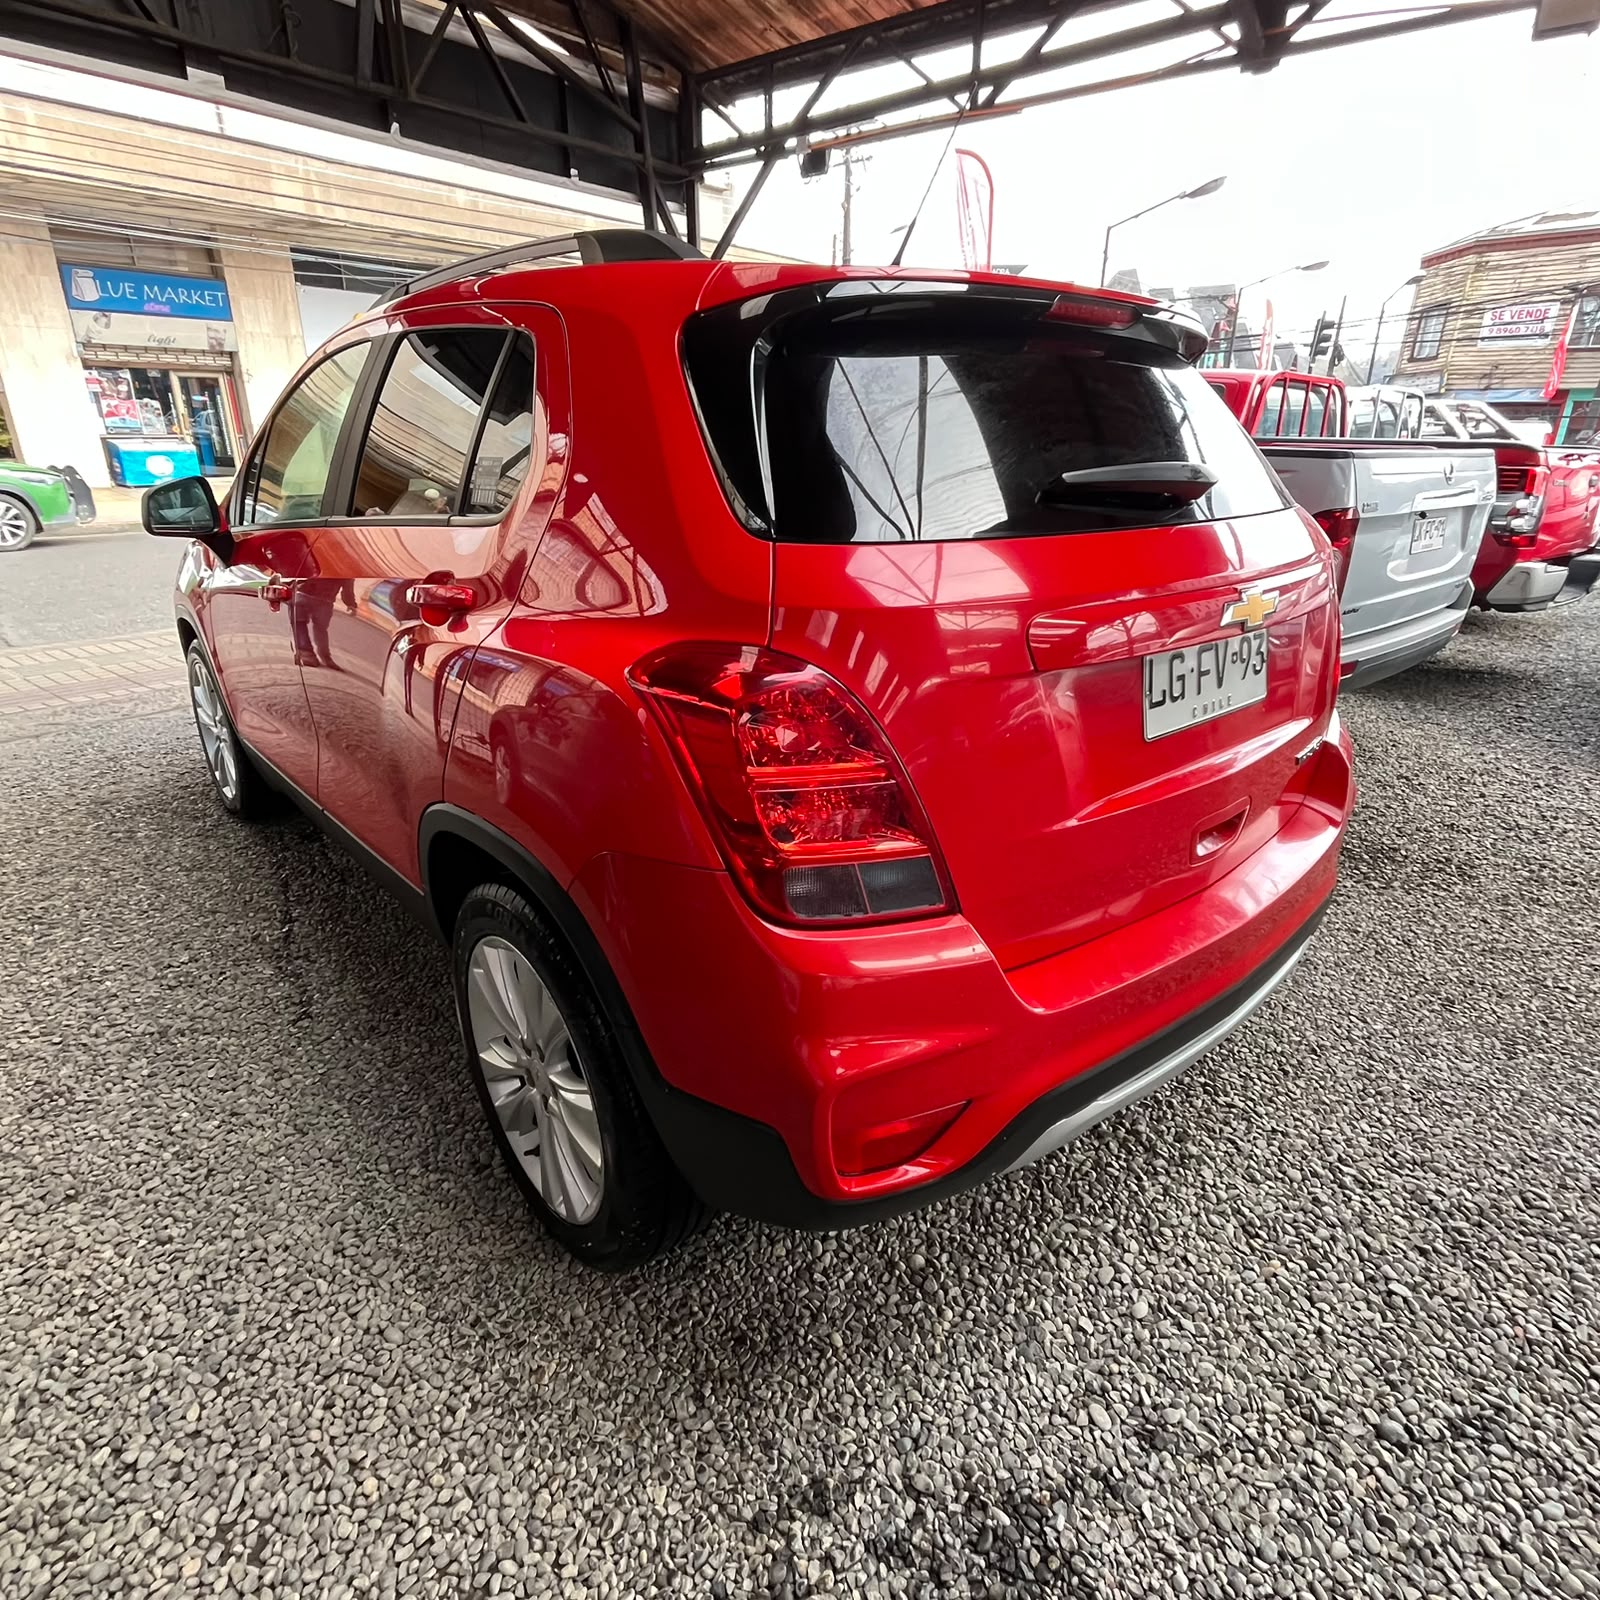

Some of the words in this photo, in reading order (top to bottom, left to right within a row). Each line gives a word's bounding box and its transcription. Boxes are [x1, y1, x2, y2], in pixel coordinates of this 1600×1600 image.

[143, 284, 226, 308] MARKET
[1490, 310, 1505, 321] SE
[1510, 308, 1551, 321] VENDE
